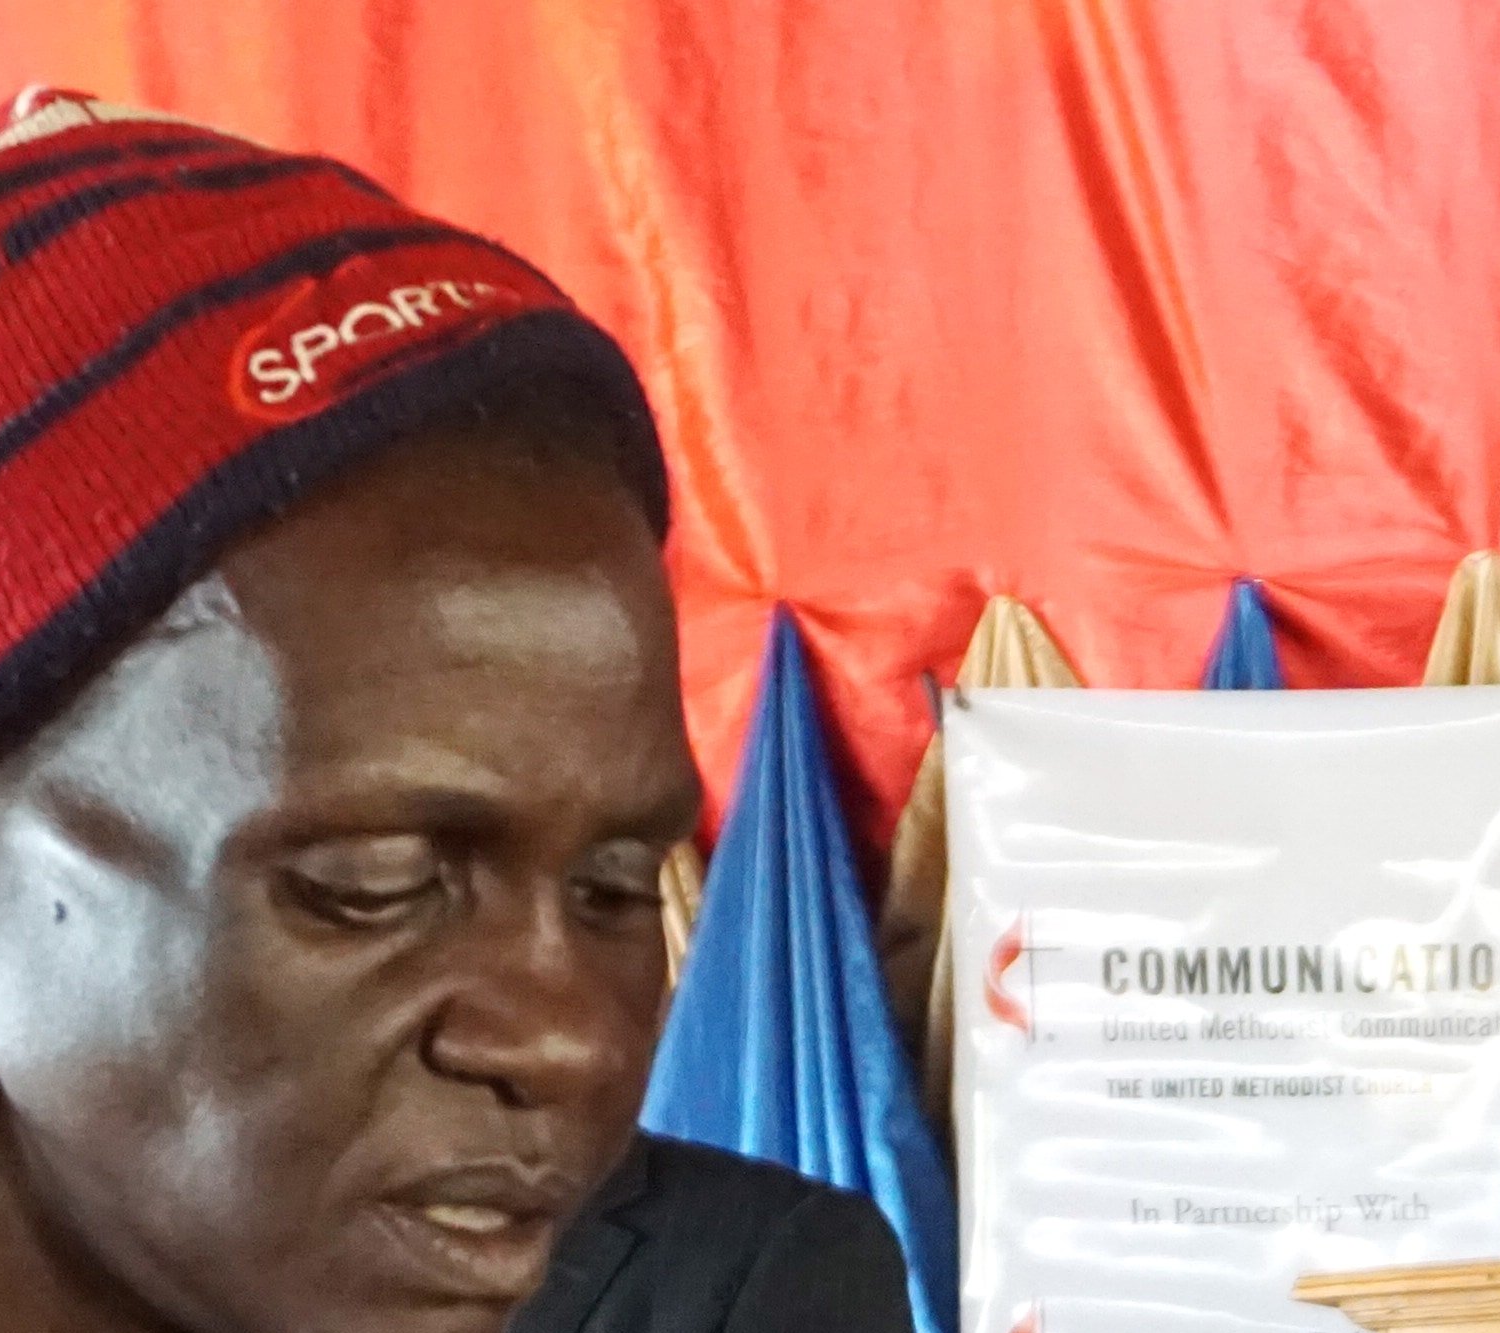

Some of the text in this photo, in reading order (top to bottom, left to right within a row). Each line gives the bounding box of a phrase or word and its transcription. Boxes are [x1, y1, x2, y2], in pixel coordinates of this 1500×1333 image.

[1102, 1013, 1188, 1044] United
[1106, 1077, 1142, 1100] THE
[1151, 1077, 1224, 1099] UNITED
[1232, 1074, 1345, 1098] METHODIST
[1130, 1191, 1431, 1233] In Partnership With
